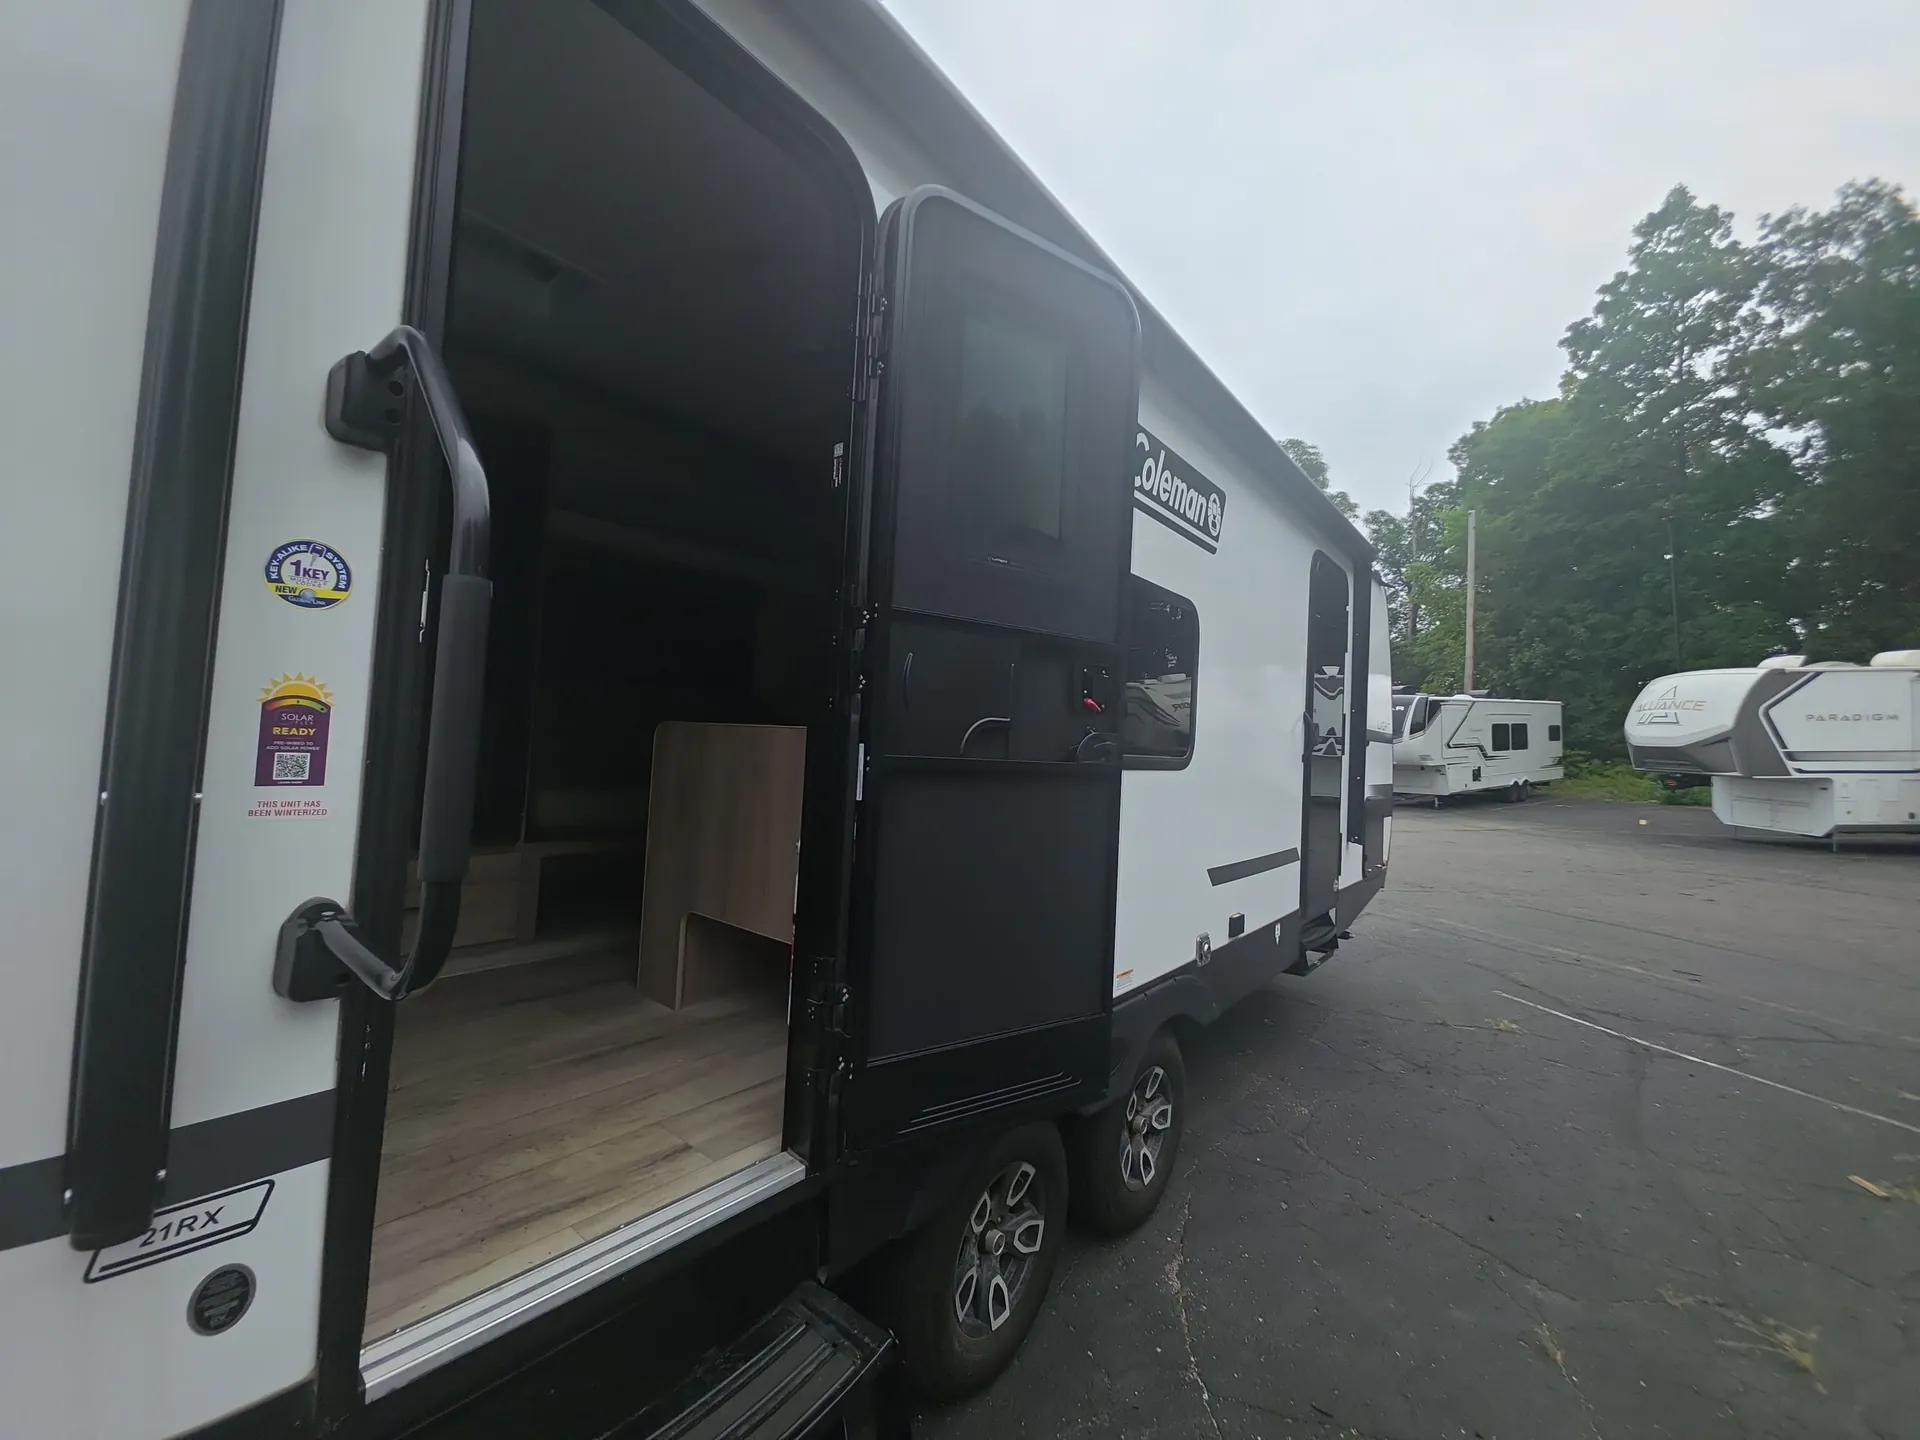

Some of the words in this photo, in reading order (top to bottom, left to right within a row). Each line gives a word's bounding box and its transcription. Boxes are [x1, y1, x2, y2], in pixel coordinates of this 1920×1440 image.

[269, 544, 309, 579] KEY-ALIKE
[325, 552, 347, 589] SYSTEM
[275, 585, 298, 595] NEW
[1636, 699, 1707, 713] ALLIANCE
[281, 713, 314, 721] SOLAR
[1806, 714, 1900, 722] PARADIGM
[272, 726, 317, 736] READY
[304, 800, 322, 808] HAS
[248, 809, 272, 817] BEEN
[273, 808, 328, 816] WINTERIZED
[139, 1206, 226, 1248] 21RX
